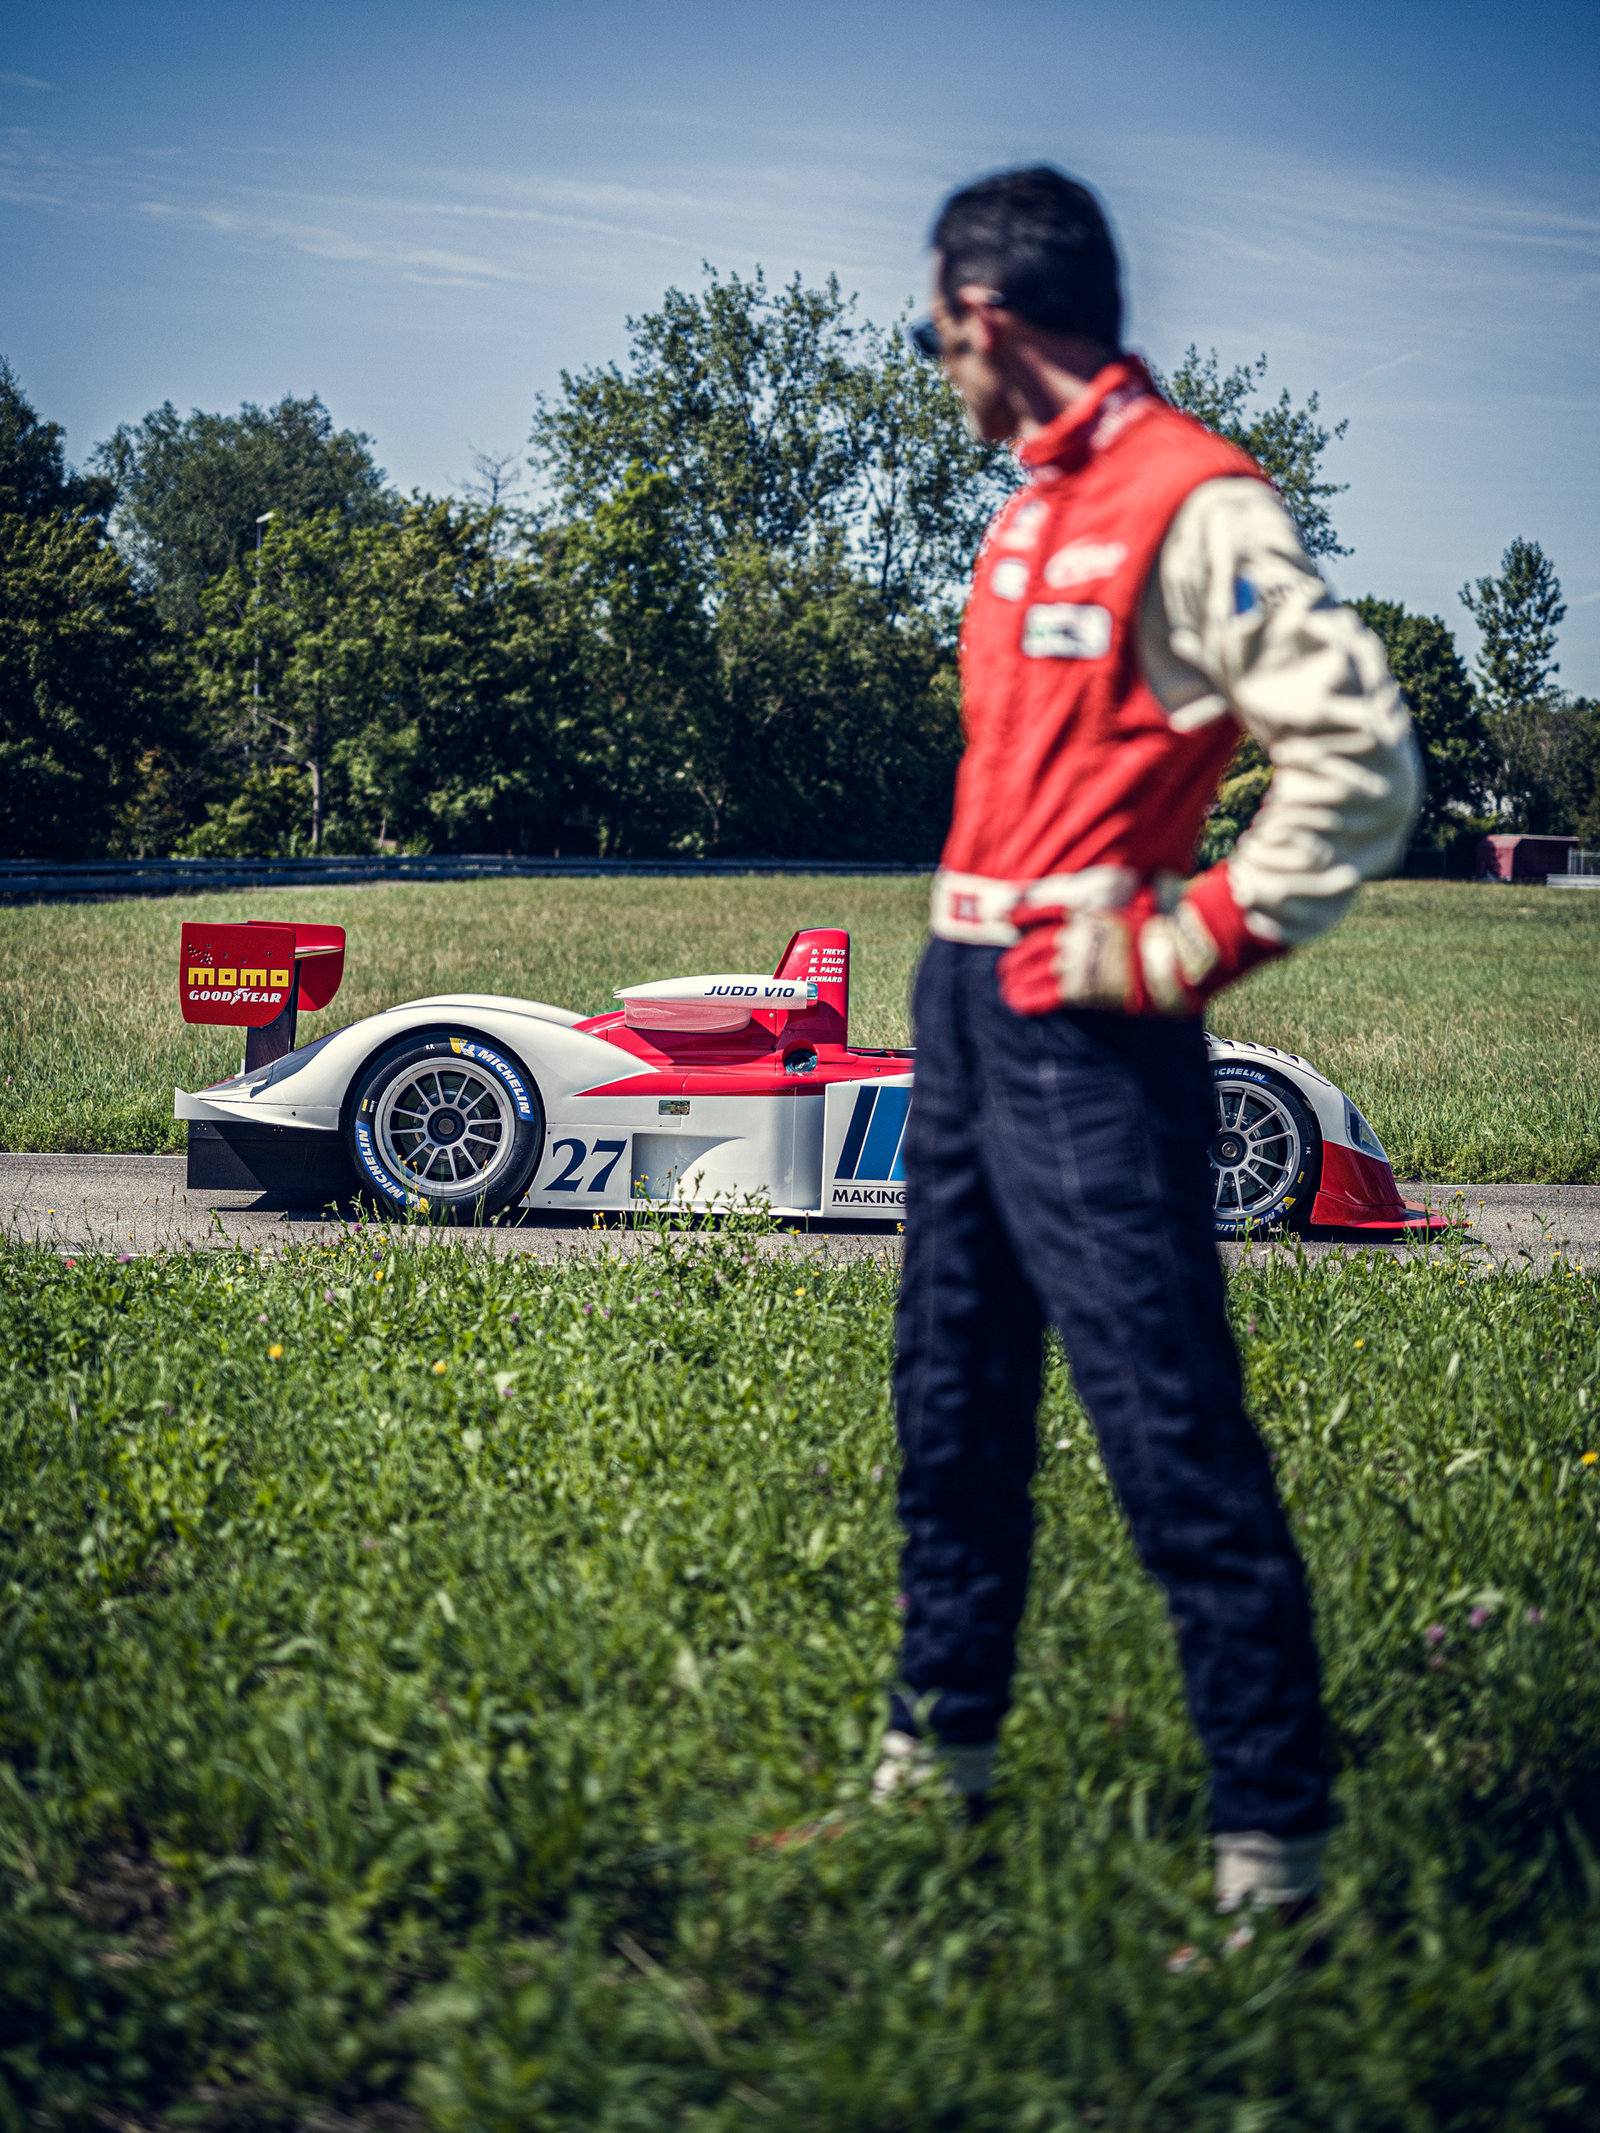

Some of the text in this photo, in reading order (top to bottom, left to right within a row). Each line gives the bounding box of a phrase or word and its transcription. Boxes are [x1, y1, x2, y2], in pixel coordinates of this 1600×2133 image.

[811, 948, 846, 956] D. THEYS
[821, 957, 845, 965] BALDI
[807, 966, 843, 974] M. PAPIS
[805, 975, 843, 983] LIENHARD
[704, 985, 795, 997] JUDD V10
[1213, 1067, 1266, 1080] ICHELIN
[477, 1049, 532, 1115] MICHELIN
[358, 1128, 405, 1199] MICHELIN
[542, 1137, 628, 1192] 27
[831, 1189, 907, 1205] MAKING
